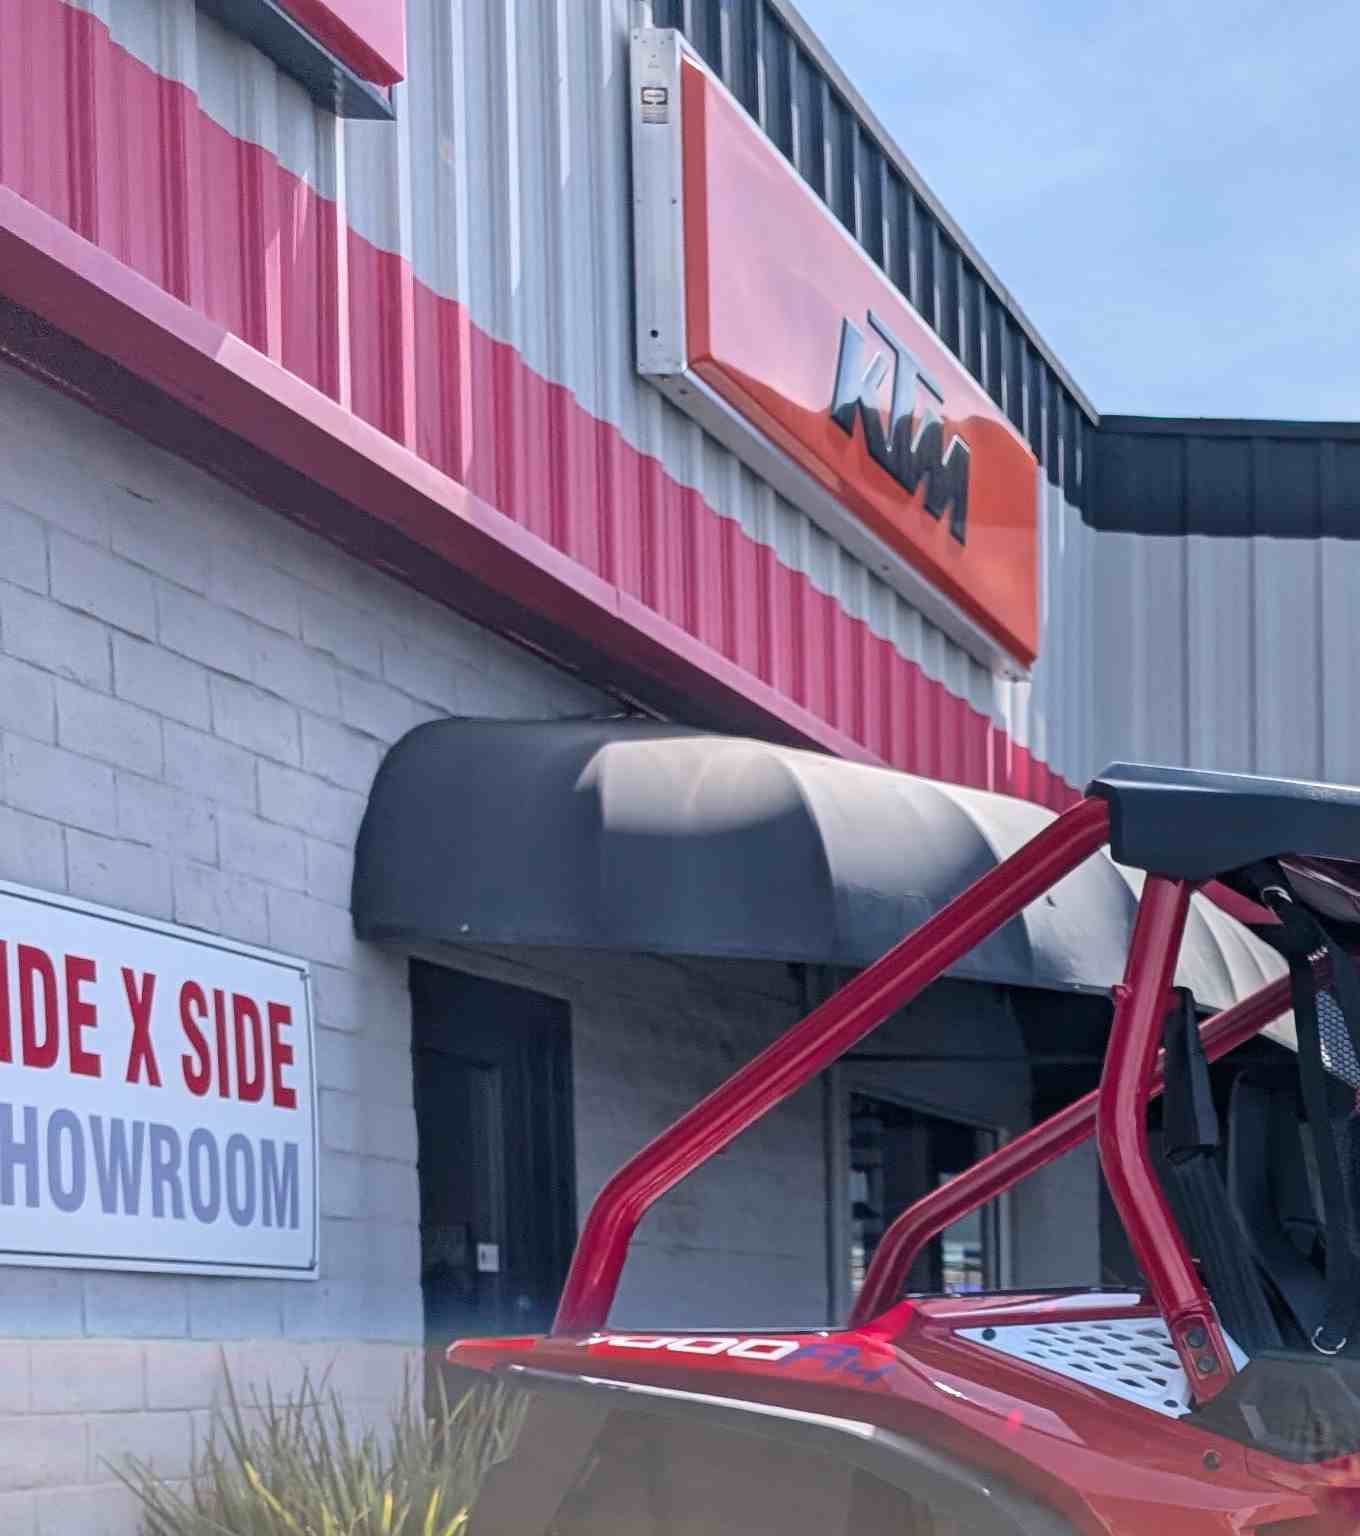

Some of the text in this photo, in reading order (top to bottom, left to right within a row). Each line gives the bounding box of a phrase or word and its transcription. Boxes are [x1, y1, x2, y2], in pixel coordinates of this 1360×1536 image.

[829, 309, 970, 546] KTM
[120, 966, 163, 1088] X
[179, 980, 298, 1110] SIDE
